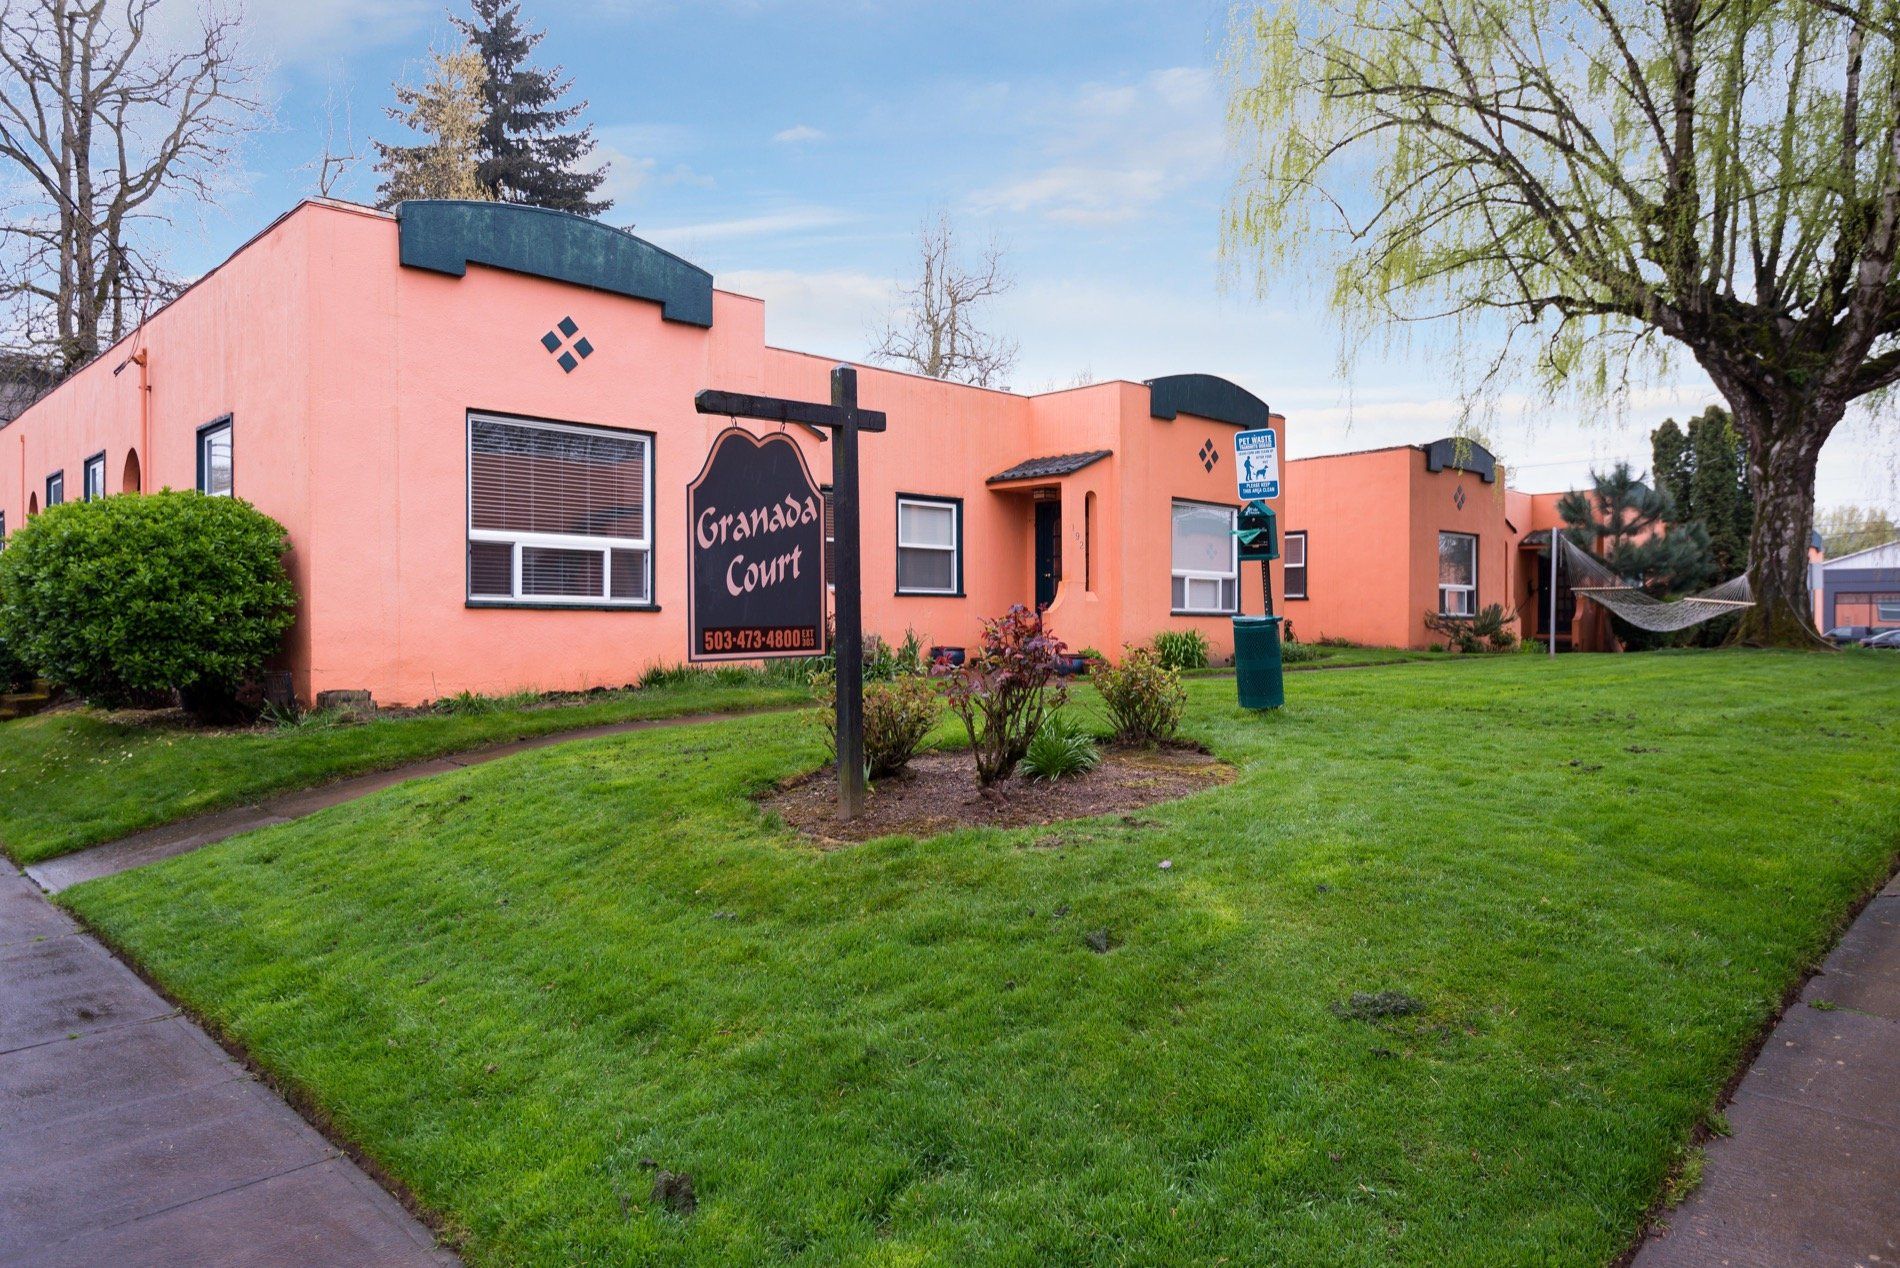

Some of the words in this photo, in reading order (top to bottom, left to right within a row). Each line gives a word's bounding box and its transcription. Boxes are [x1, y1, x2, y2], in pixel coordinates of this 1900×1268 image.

[1238, 437, 1250, 445] PET
[1251, 435, 1272, 444] WASTE
[697, 492, 818, 550] Granada
[726, 543, 802, 597] Court
[801, 629, 815, 638] EXT
